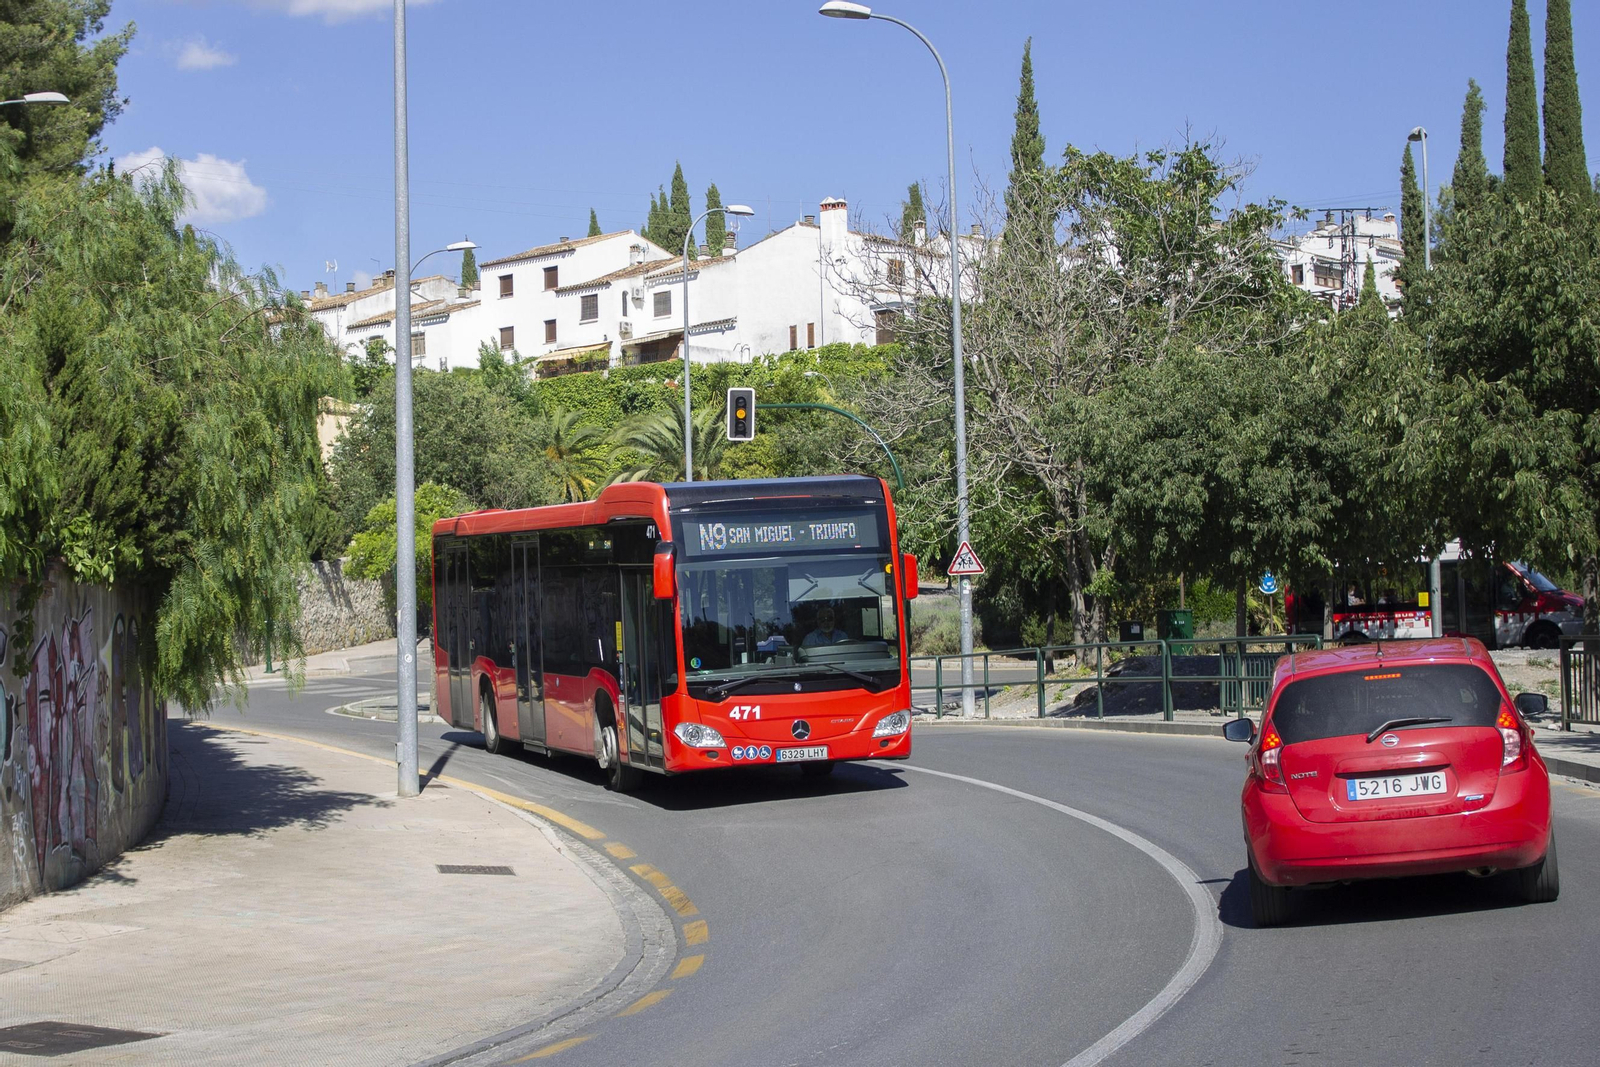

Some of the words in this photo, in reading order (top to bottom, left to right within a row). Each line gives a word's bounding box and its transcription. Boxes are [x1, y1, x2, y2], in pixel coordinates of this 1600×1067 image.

[646, 525, 656, 539] 471
[699, 522, 728, 550] N9
[729, 527, 751, 544] SAN
[755, 525, 796, 543] MIGUEL
[809, 522, 857, 541] TRIUNFO
[729, 705, 761, 720] 471
[781, 749, 805, 760] 6329
[807, 748, 825, 758] LHY
[1290, 770, 1318, 780] NOTE
[1358, 778, 1402, 796] 5216
[1410, 774, 1441, 792] JWG
